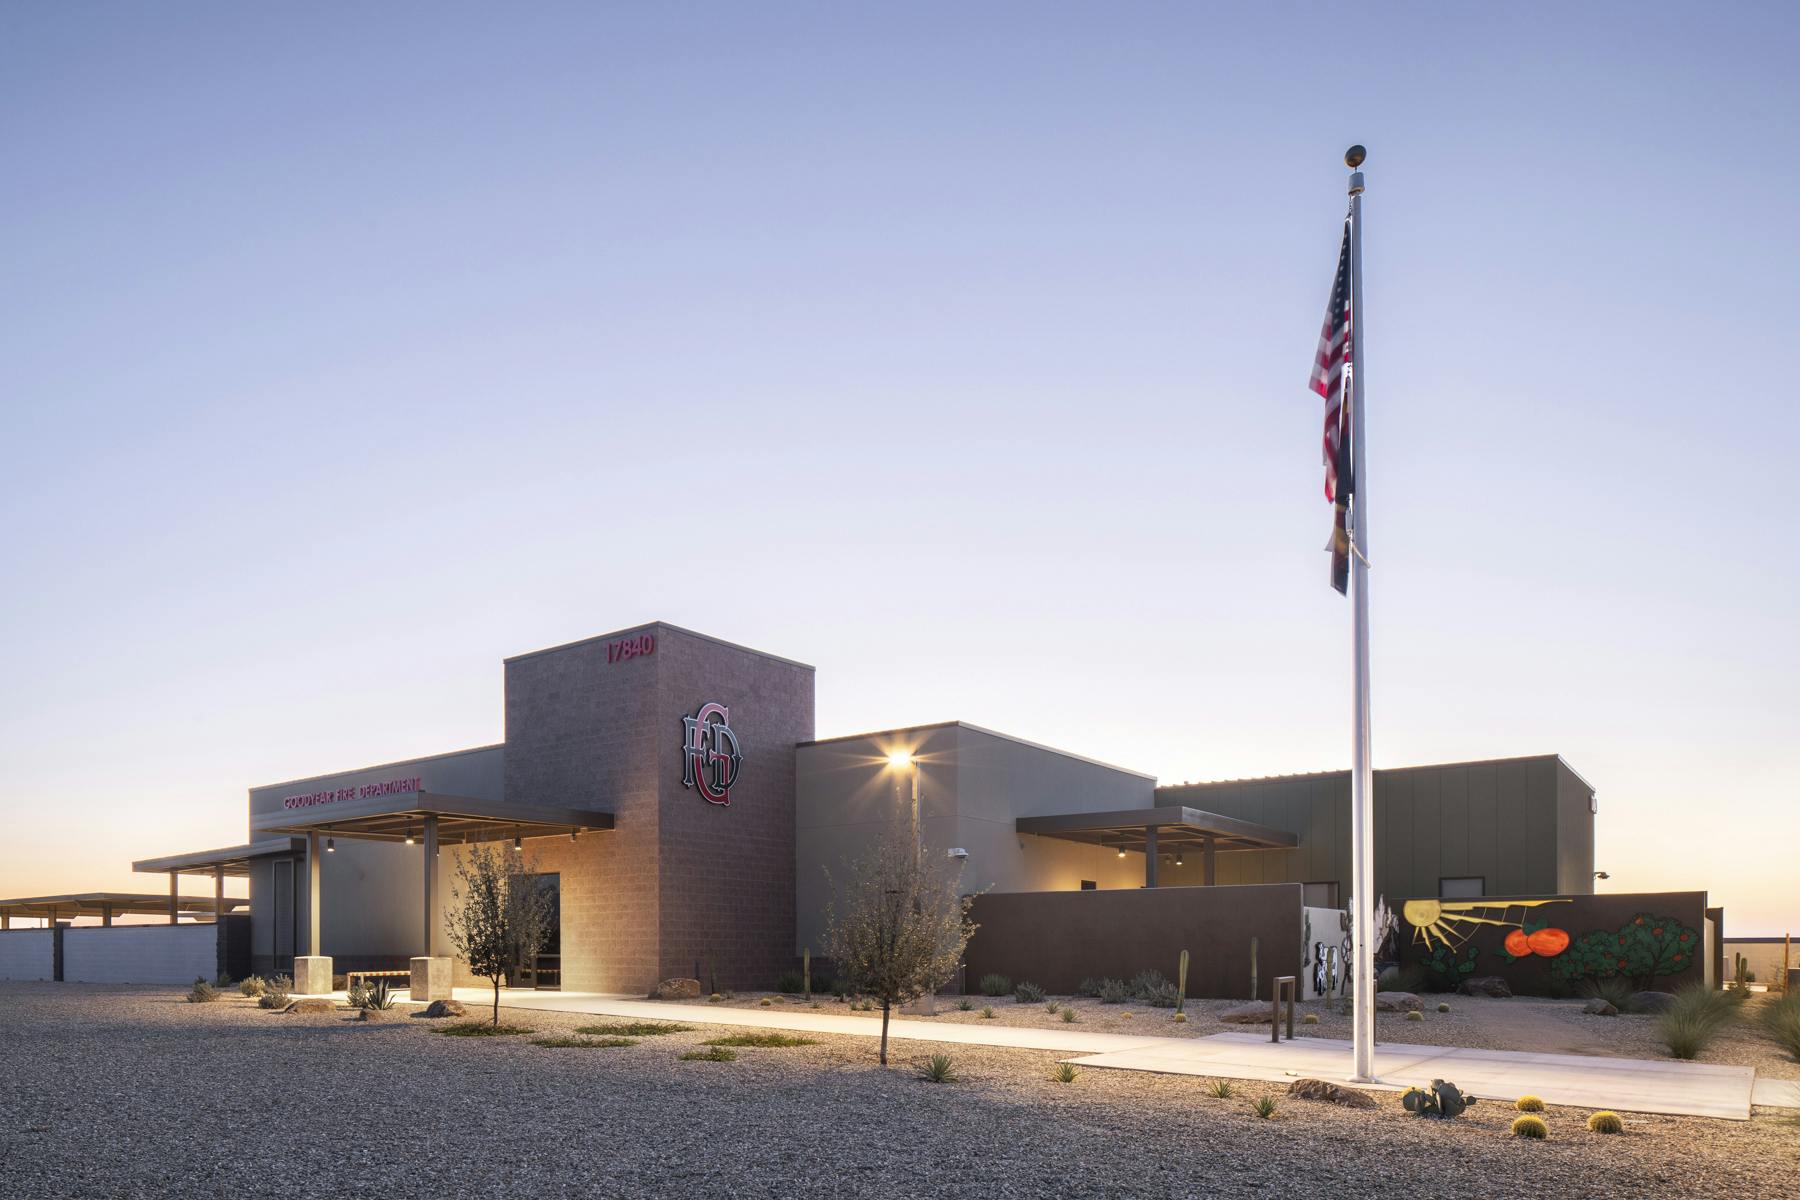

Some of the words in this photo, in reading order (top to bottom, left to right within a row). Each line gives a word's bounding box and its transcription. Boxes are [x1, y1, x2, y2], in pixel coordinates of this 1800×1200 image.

[608, 635, 655, 663] 17840
[283, 791, 334, 809] GOODYEAR
[335, 785, 355, 802] FIRE
[359, 777, 421, 798] DEPARTMENT
